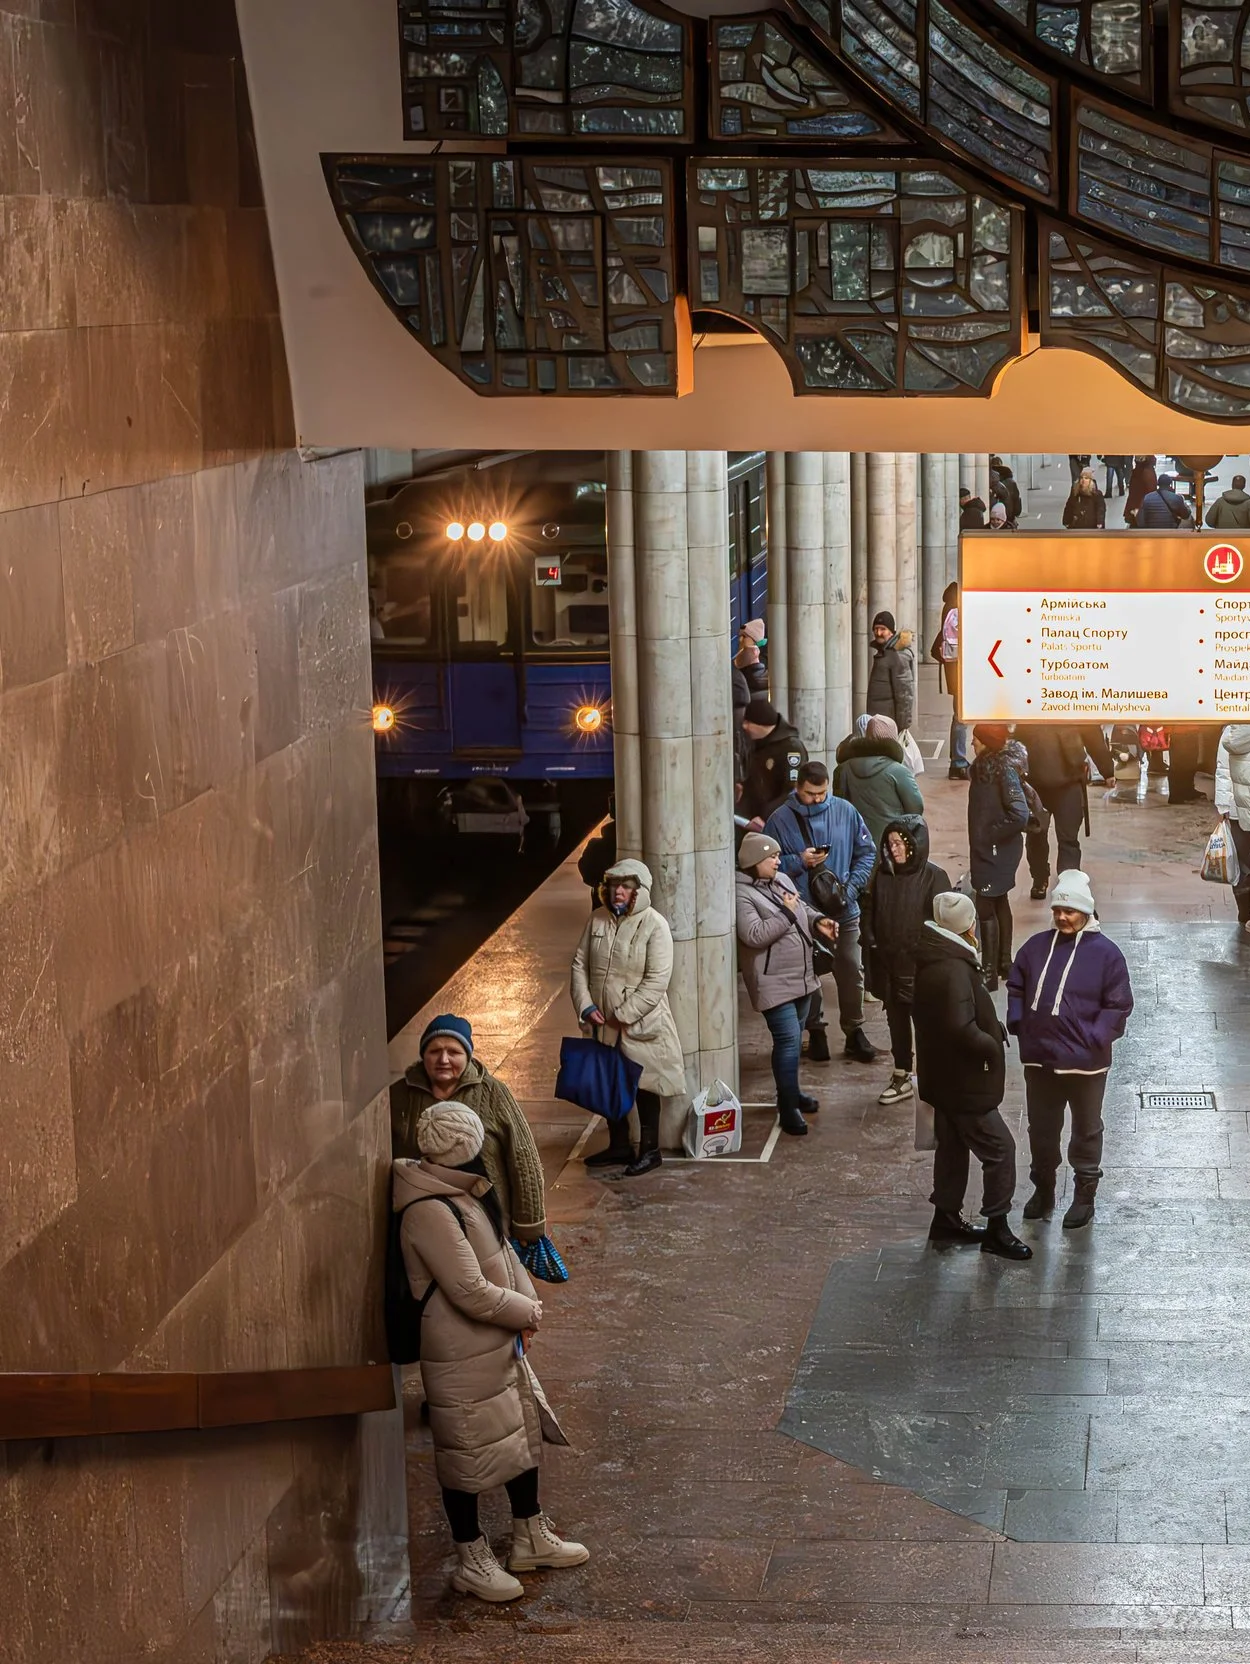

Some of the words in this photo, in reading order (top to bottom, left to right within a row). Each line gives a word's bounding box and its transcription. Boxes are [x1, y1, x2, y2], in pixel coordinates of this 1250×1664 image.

[549, 567, 558, 580] 4
[1040, 598, 1106, 612] Армійська
[1041, 627, 1080, 640] Палац
[1082, 627, 1128, 640] Спорту
[1040, 657, 1109, 671] Турбоатом
[1040, 688, 1079, 701] Завод
[1081, 688, 1098, 701] ім.
[1100, 688, 1168, 701] Малишева
[1040, 702, 1070, 712] Zavod
[1072, 702, 1099, 712] Imeni
[1102, 702, 1151, 714] Malysheva
